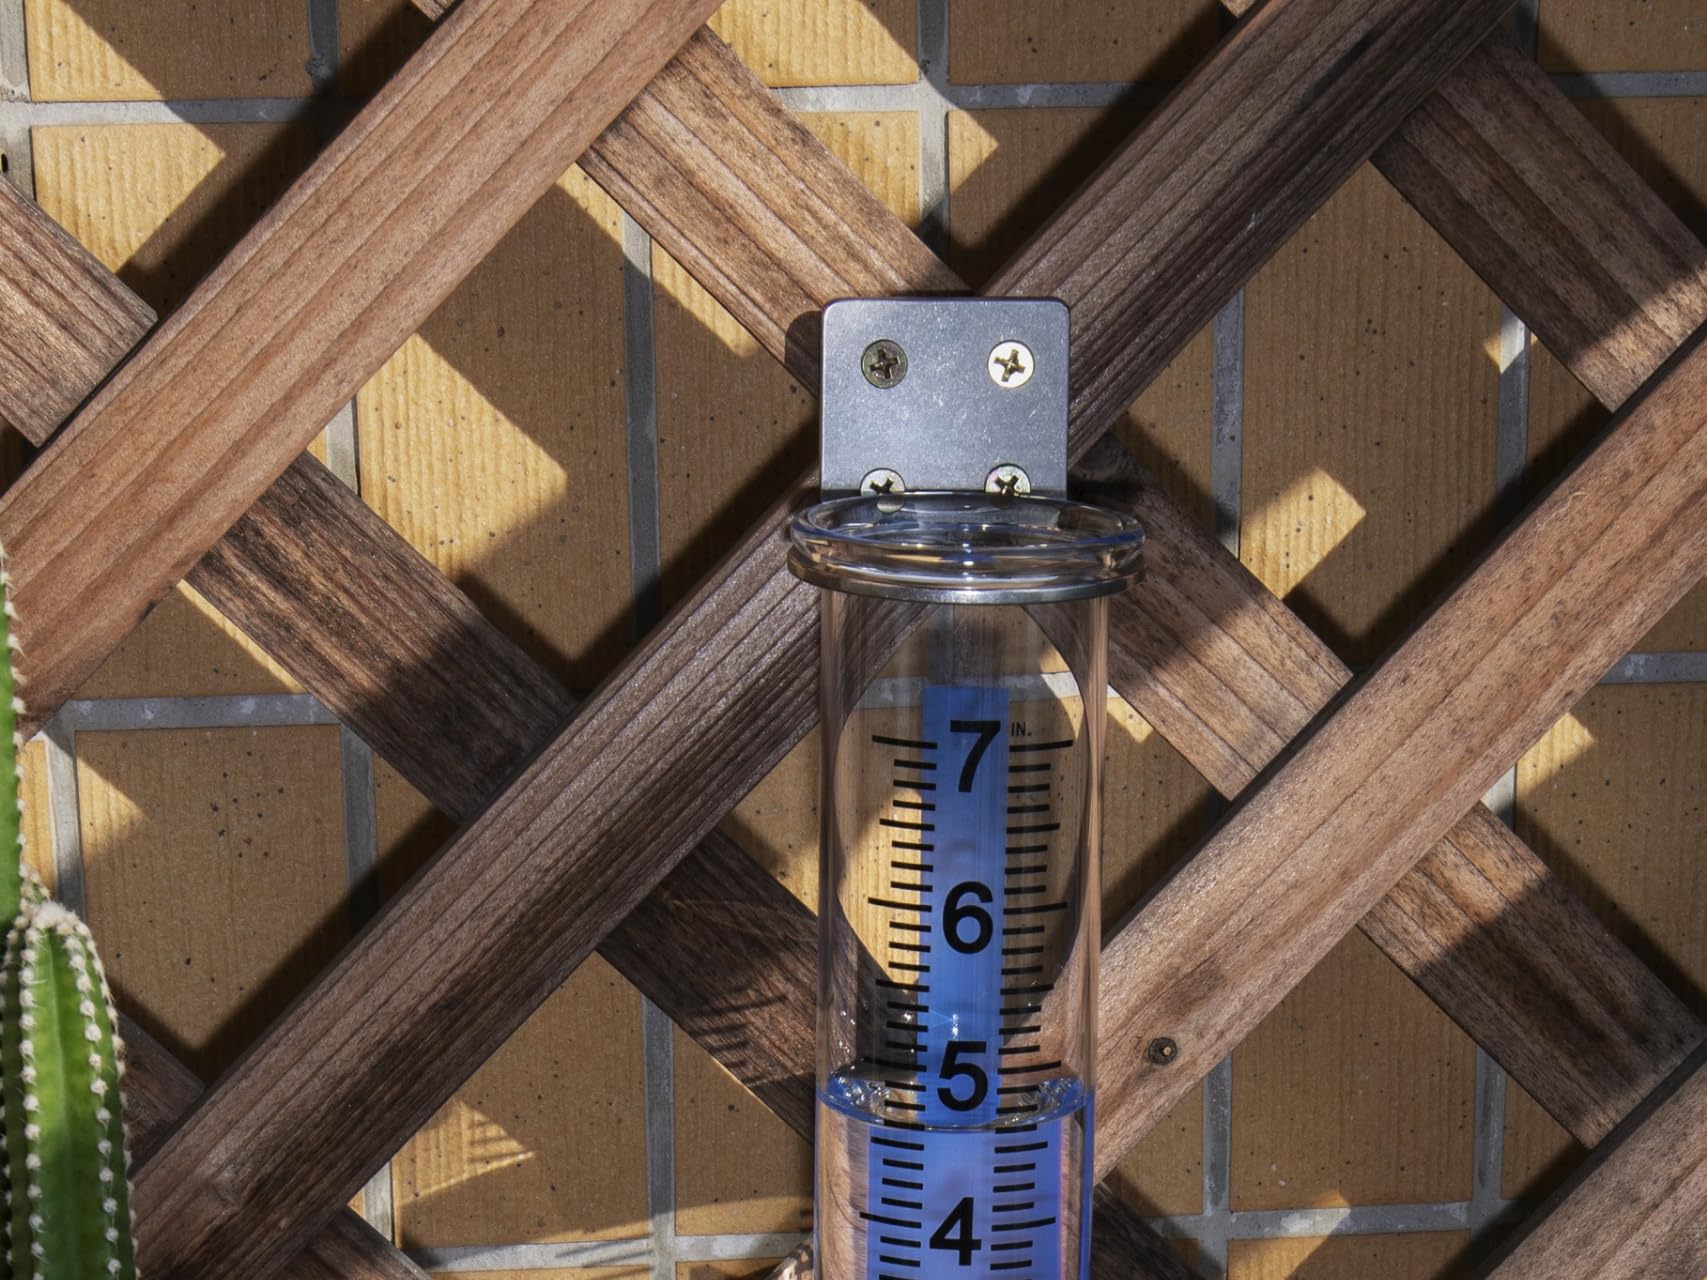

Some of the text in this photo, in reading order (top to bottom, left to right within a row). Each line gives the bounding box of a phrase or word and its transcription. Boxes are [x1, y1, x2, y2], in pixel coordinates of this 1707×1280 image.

[950, 720, 1032, 792] 7 IN.
[943, 882, 993, 953] 6
[938, 1041, 987, 1111] 5
[930, 1197, 981, 1266] 4
